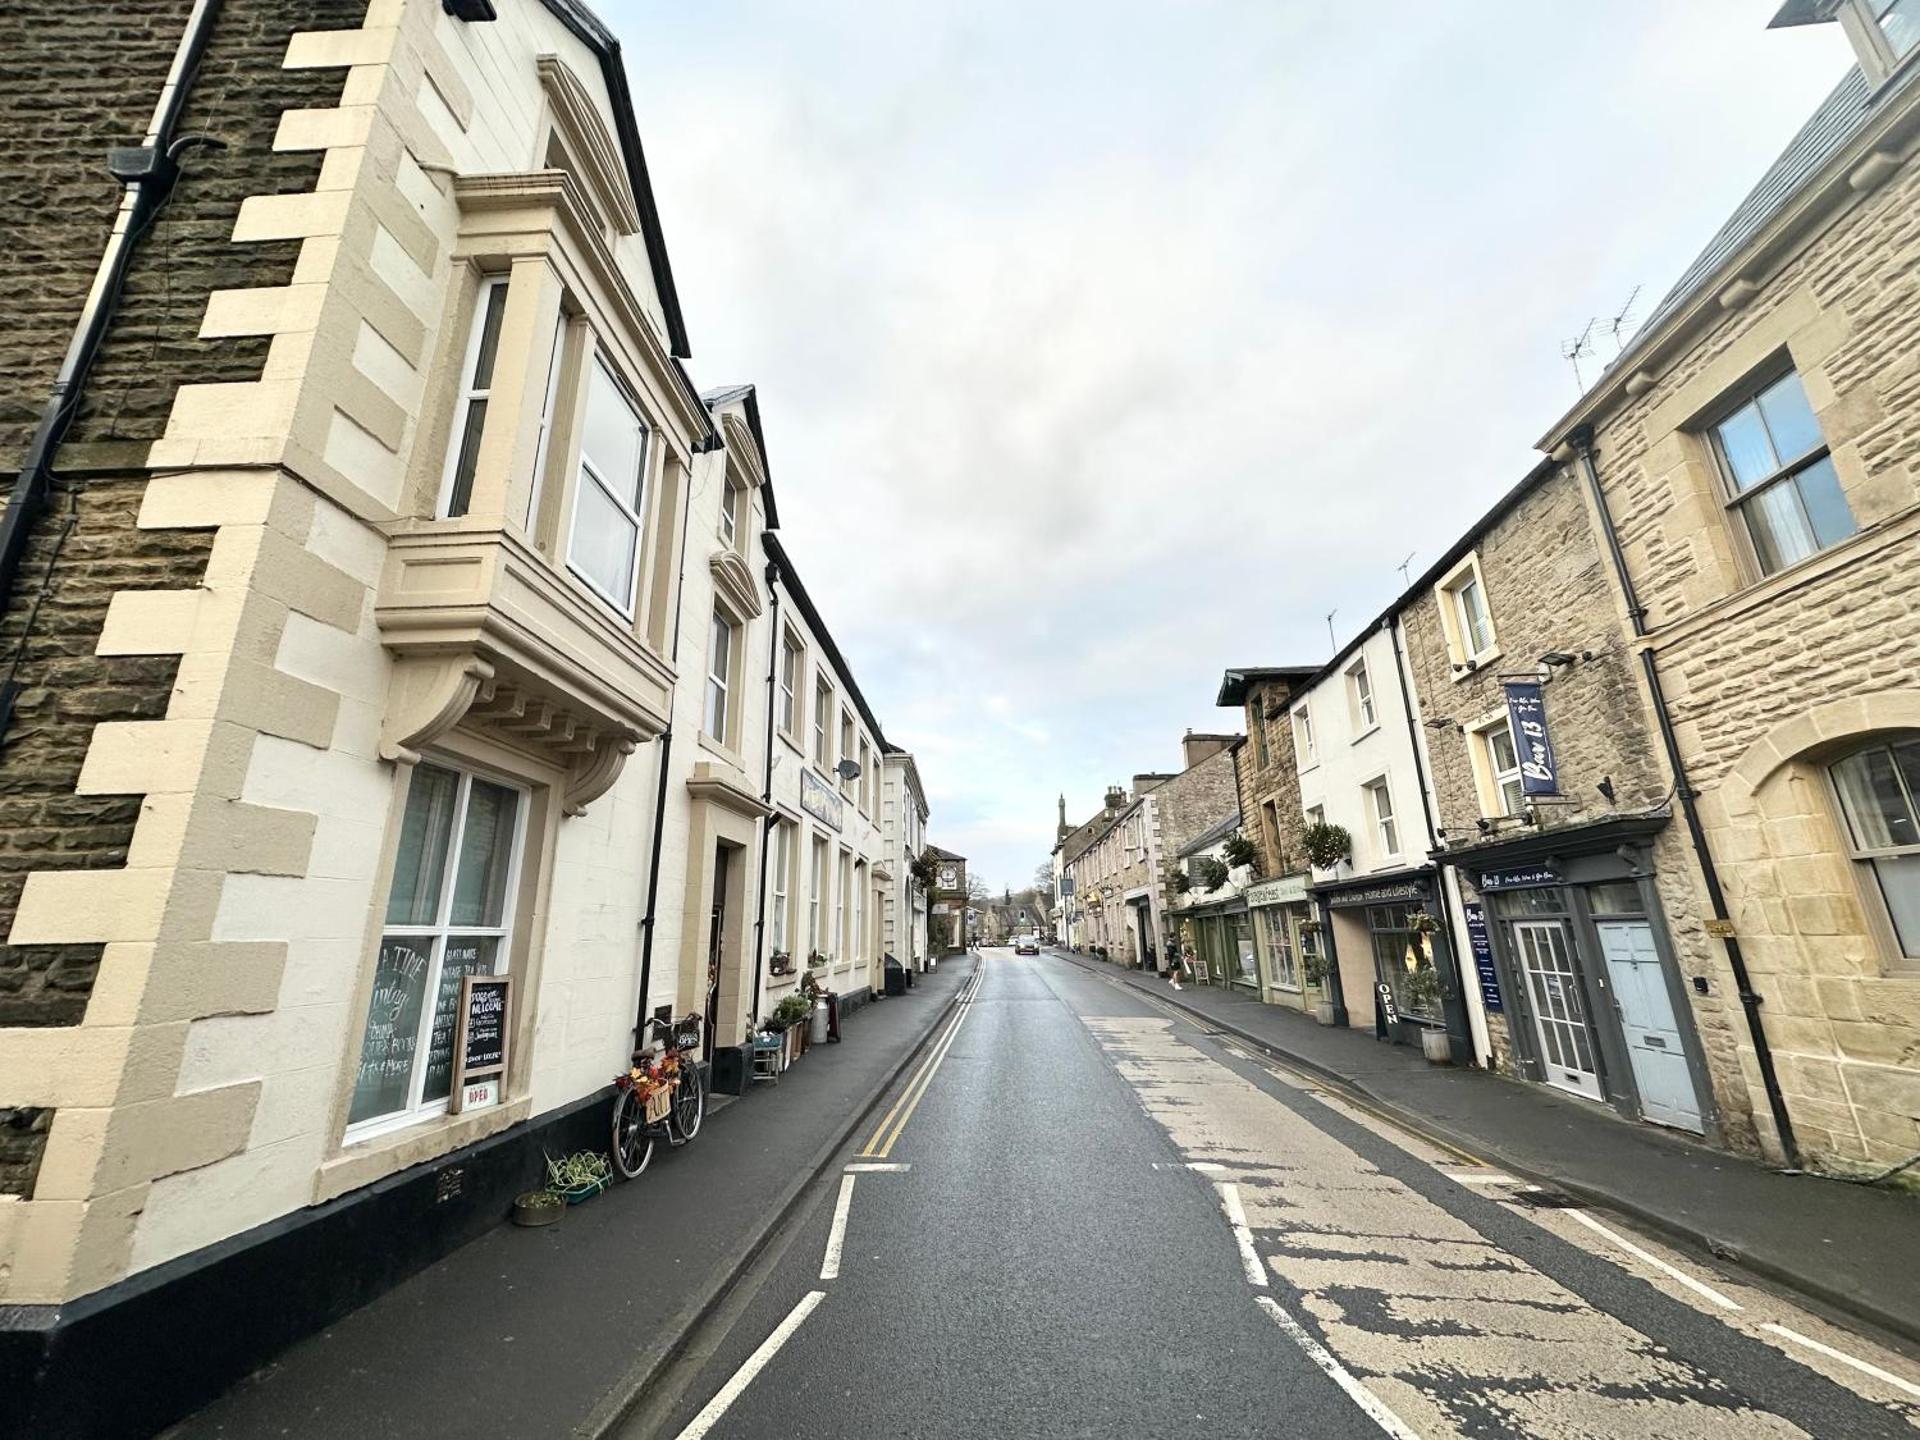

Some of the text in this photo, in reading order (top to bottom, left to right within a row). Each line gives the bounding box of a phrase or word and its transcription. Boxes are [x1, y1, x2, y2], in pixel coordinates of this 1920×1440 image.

[1520, 720, 1553, 781] Bar 13
[1481, 874, 1493, 888] Bar
[1467, 908, 1478, 922] Bar
[393, 945, 428, 983] TIME
[471, 1000, 504, 1015] WELCOME
[1379, 983, 1398, 1024] OPEN
